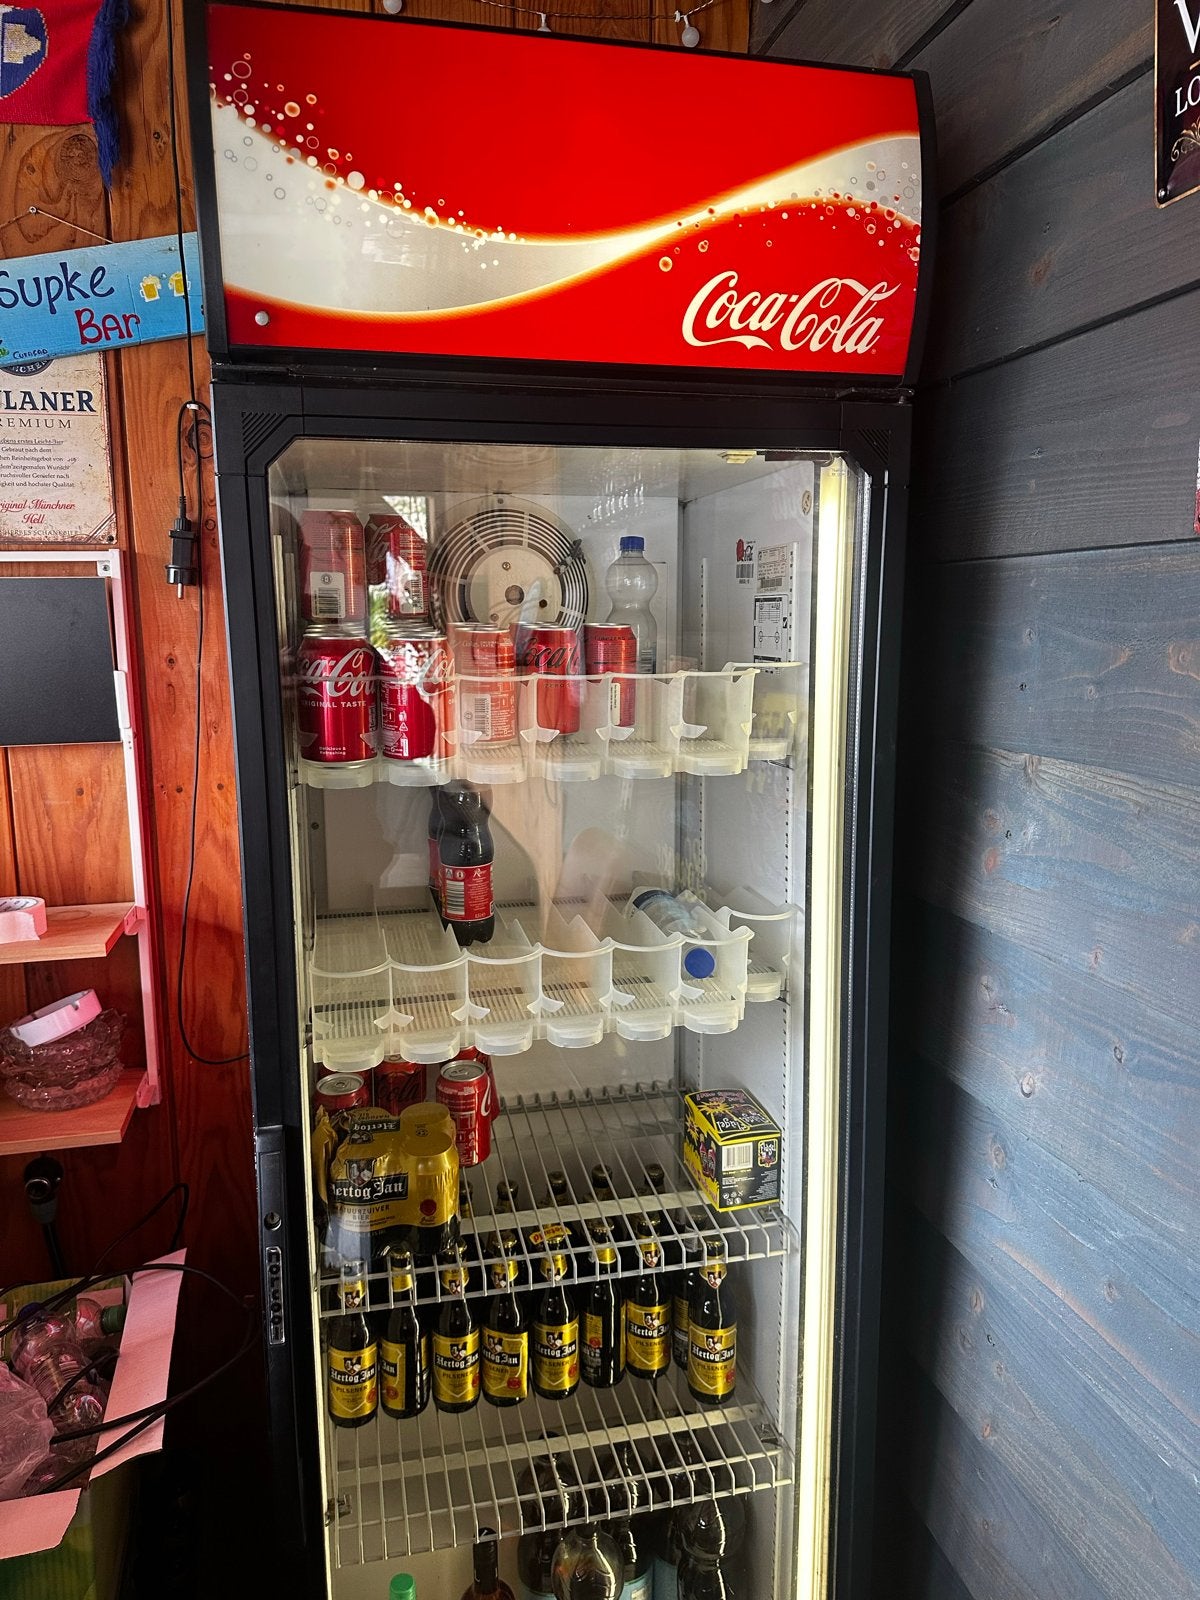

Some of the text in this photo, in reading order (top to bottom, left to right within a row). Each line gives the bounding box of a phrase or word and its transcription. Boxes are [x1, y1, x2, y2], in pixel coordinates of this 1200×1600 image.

[682, 271, 901, 354] Coca-Cola
[0, 390, 96, 412] LANER
[0, 417, 71, 429] EMIUM
[341, 700, 367, 708] TASTE
[372, 1177, 404, 1200] Jan
[501, 1353, 518, 1364] Jan
[561, 1344, 576, 1358] Jan
[692, 1345, 735, 1361] Hertog Jan
[436, 1352, 479, 1369] Hertog Jan
[330, 1367, 375, 1383] Hertog Jan
